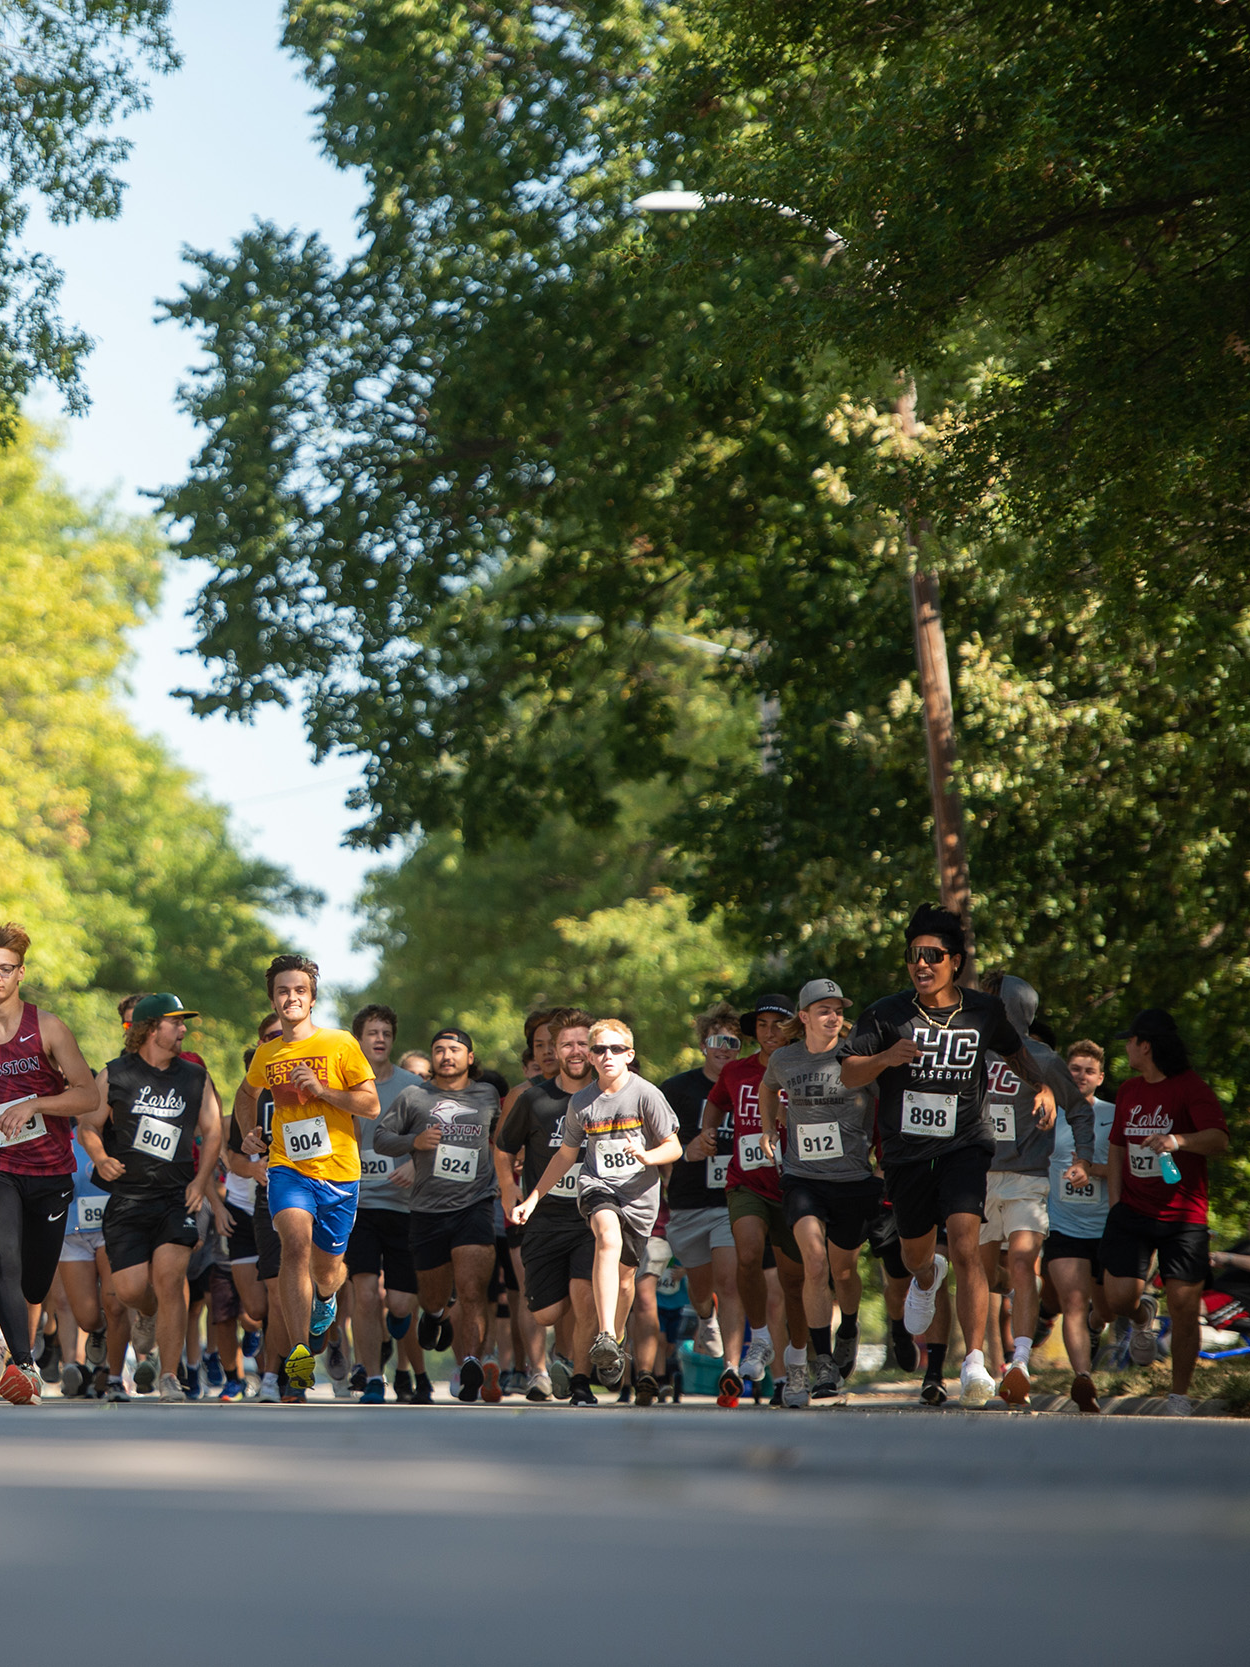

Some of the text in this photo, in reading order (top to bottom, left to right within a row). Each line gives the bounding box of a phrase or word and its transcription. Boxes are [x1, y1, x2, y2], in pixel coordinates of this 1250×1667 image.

[824, 981, 836, 993] B
[909, 1027, 980, 1069] HC
[266, 1058, 327, 1077] HESSTON
[910, 1069, 973, 1080] BASEBALL
[787, 1073, 833, 1090] PROPERTY
[134, 1085, 184, 1109] Larks
[910, 1106, 947, 1127] 898
[1126, 1104, 1171, 1128] Larks
[904, 1125, 953, 1135] timerguys.com
[141, 1130, 171, 1151] 900
[290, 1131, 322, 1153] 904
[803, 1136, 835, 1153] 912
[603, 1152, 636, 1168] 888
[745, 1146, 772, 1162] 90
[361, 1160, 387, 1174] 920
[440, 1157, 470, 1174] 924
